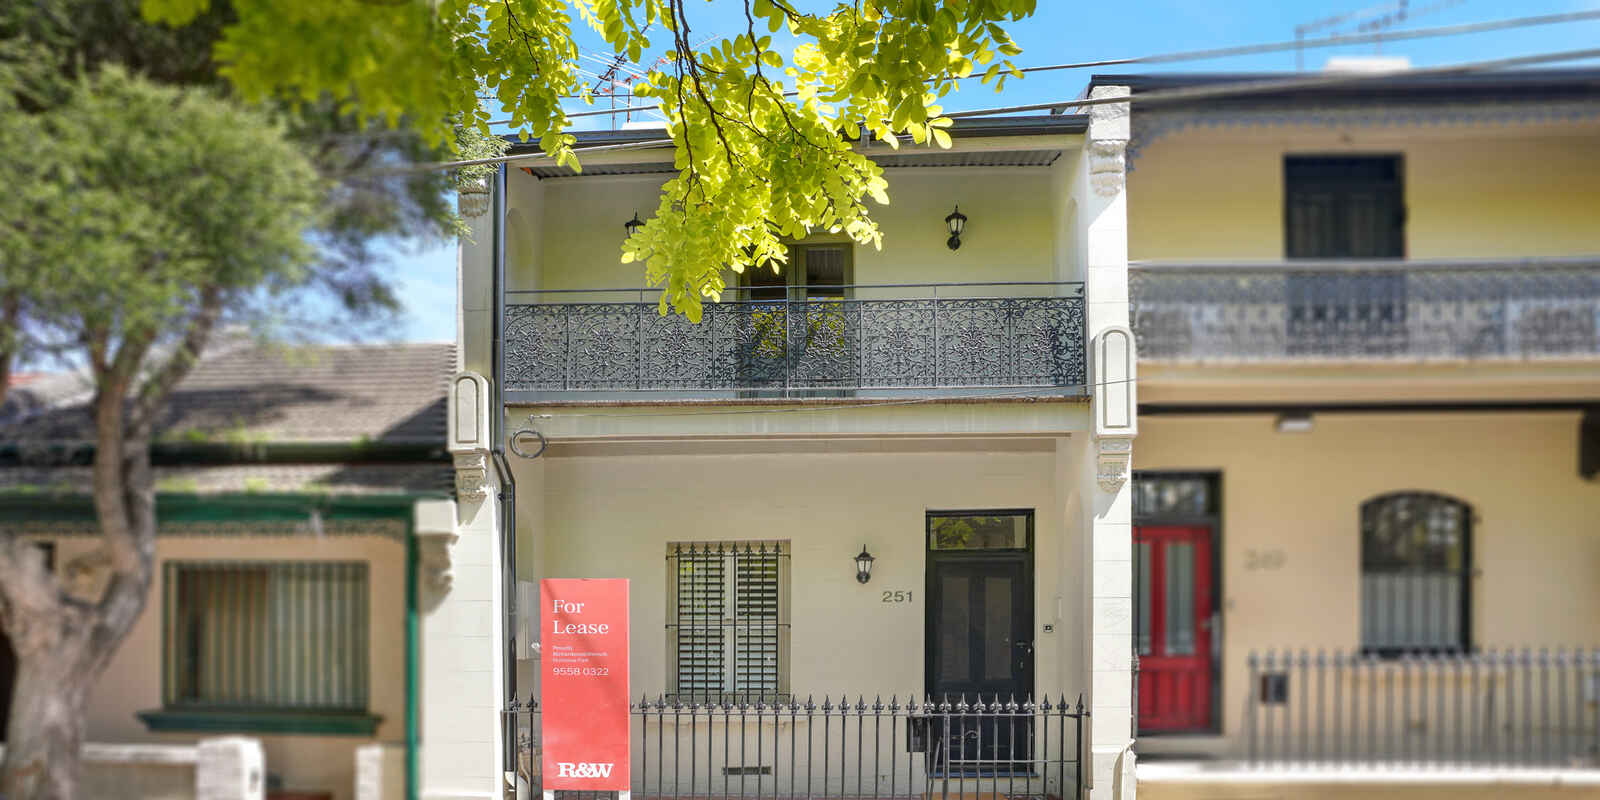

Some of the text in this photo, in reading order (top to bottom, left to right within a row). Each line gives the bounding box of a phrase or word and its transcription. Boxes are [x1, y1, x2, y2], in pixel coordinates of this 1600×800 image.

[882, 590, 913, 603] 251
[552, 599, 585, 614] For
[552, 620, 609, 634] Lease
[552, 666, 609, 676] 9558 0322
[557, 762, 615, 778] R&W
